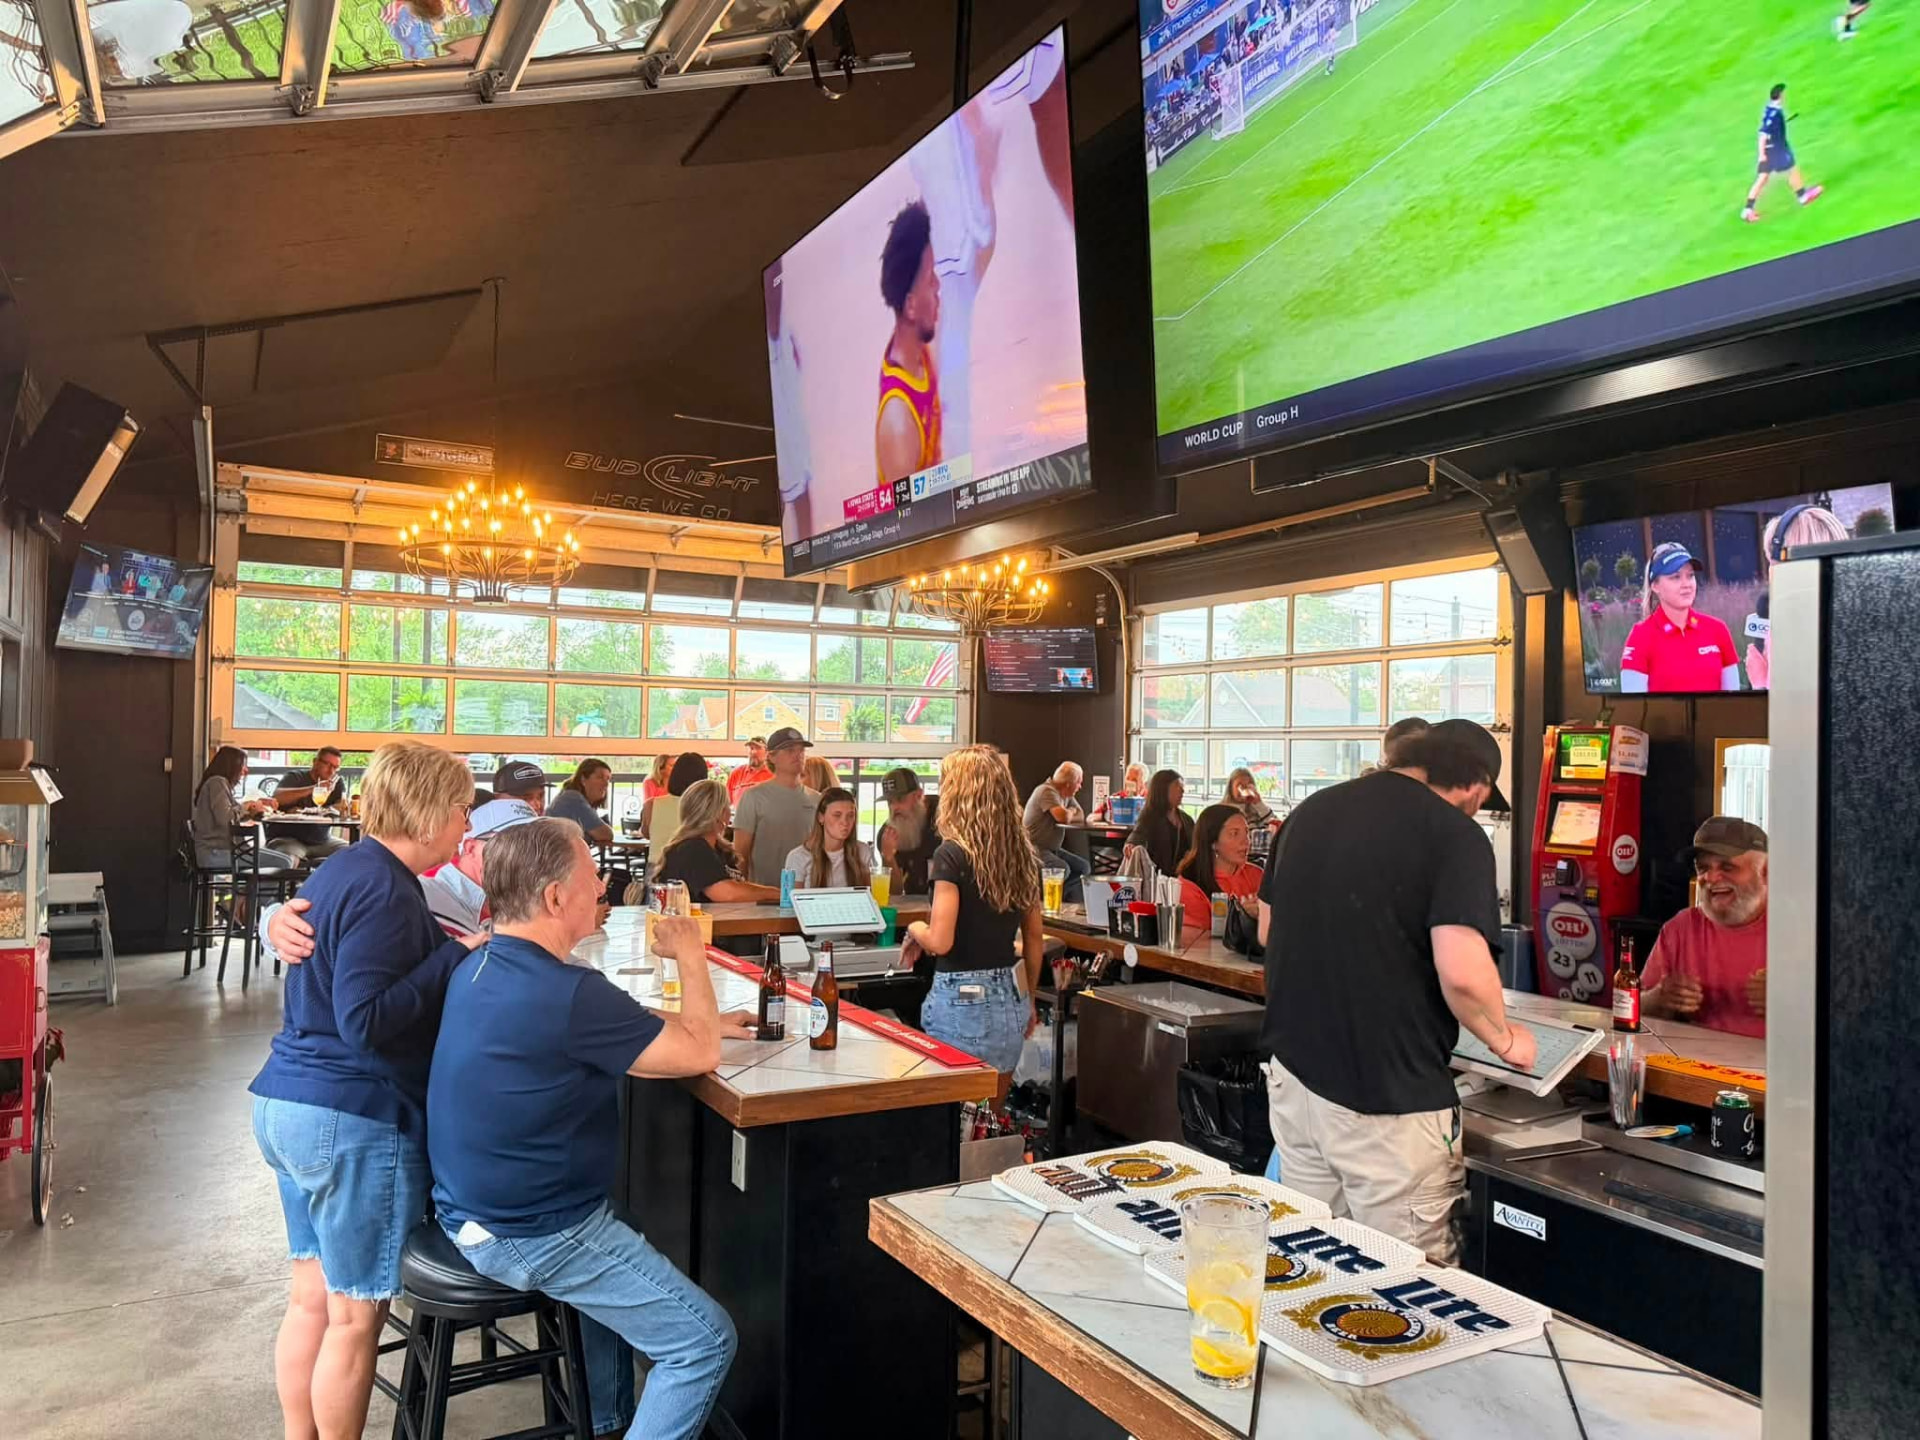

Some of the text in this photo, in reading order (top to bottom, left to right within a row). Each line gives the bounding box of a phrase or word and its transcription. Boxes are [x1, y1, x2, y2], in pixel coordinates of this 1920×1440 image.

[1256, 404, 1299, 429] Group H
[1184, 421, 1244, 448] WORLD CUP
[563, 450, 642, 476] BUD
[1020, 465, 1031, 480] APP
[664, 464, 761, 493] LIGHT
[913, 475, 926, 496] 57
[591, 490, 731, 521] HERE WE GO
[879, 488, 892, 509] 54
[855, 522, 869, 533] Spain
[1553, 951, 1570, 968] 23
[1584, 971, 1598, 984] 11
[1268, 1225, 1386, 1275] Lite
[1371, 1276, 1512, 1334] Lite
